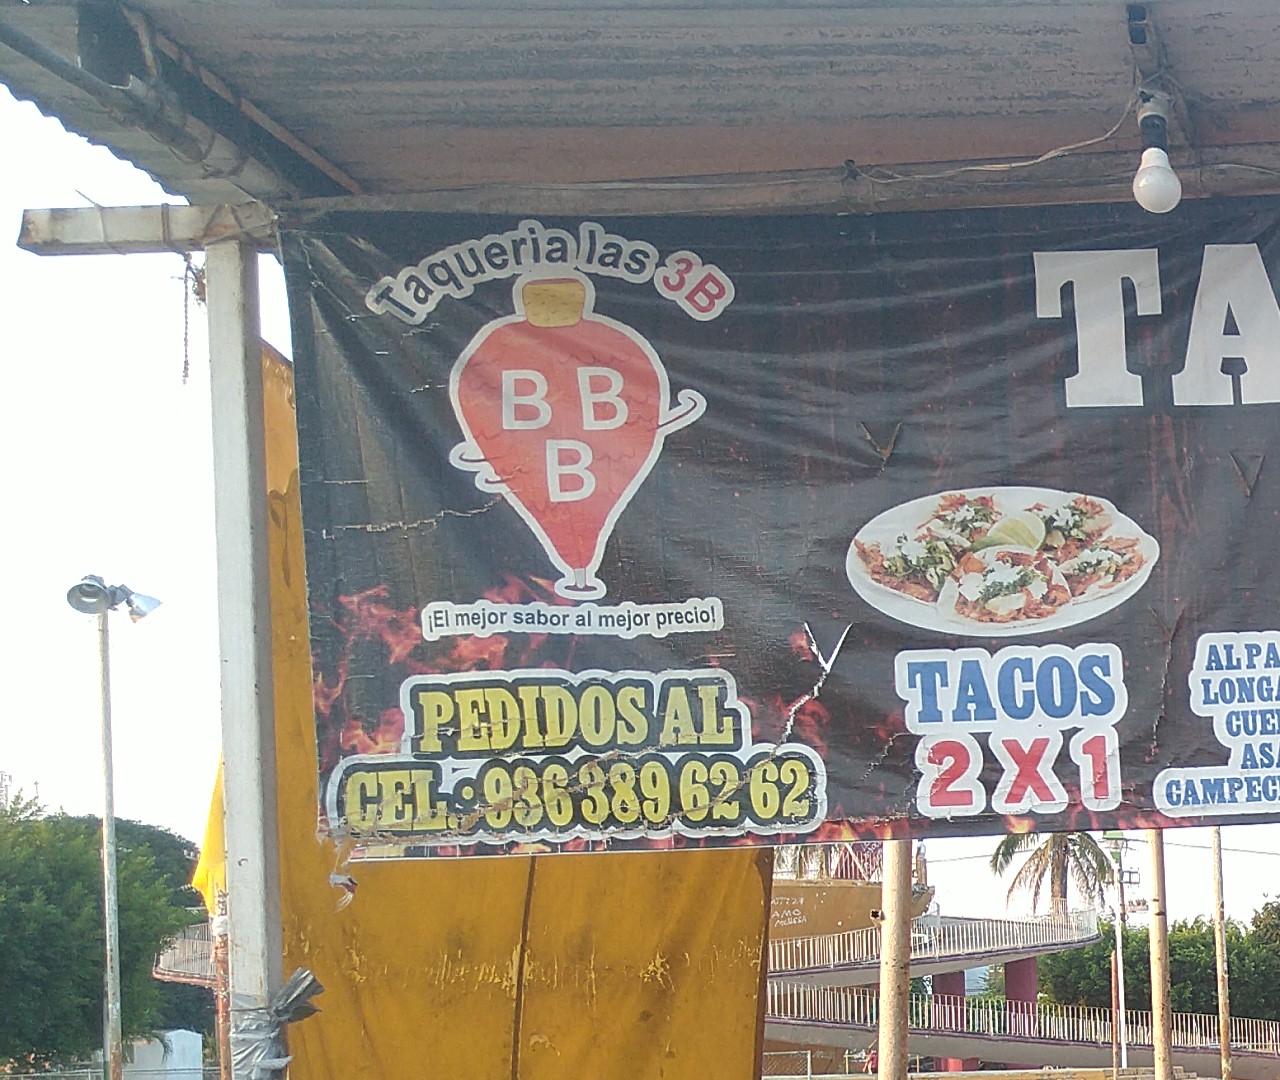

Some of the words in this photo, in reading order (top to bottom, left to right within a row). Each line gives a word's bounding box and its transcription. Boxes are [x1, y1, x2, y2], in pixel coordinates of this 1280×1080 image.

[376, 228, 568, 319] Taqueria
[587, 230, 650, 274] las
[662, 258, 726, 313] 3B
[502, 369, 552, 430] B
[577, 366, 629, 430] B
[546, 439, 596, 502] B
[428, 609, 450, 632] ¡El
[455, 607, 507, 630] mejor
[513, 608, 570, 626] sabor
[575, 609, 592, 627] al
[599, 608, 651, 631] mejor
[656, 605, 716, 629] precio!
[907, 653, 1117, 726] TACOS
[1206, 644, 1241, 671] AL
[417, 685, 649, 754] PEDIDOS
[658, 682, 736, 746] AL
[484, 762, 574, 830] 936
[578, 758, 672, 826] 389
[678, 758, 742, 823] 62
[749, 758, 812, 823] 62
